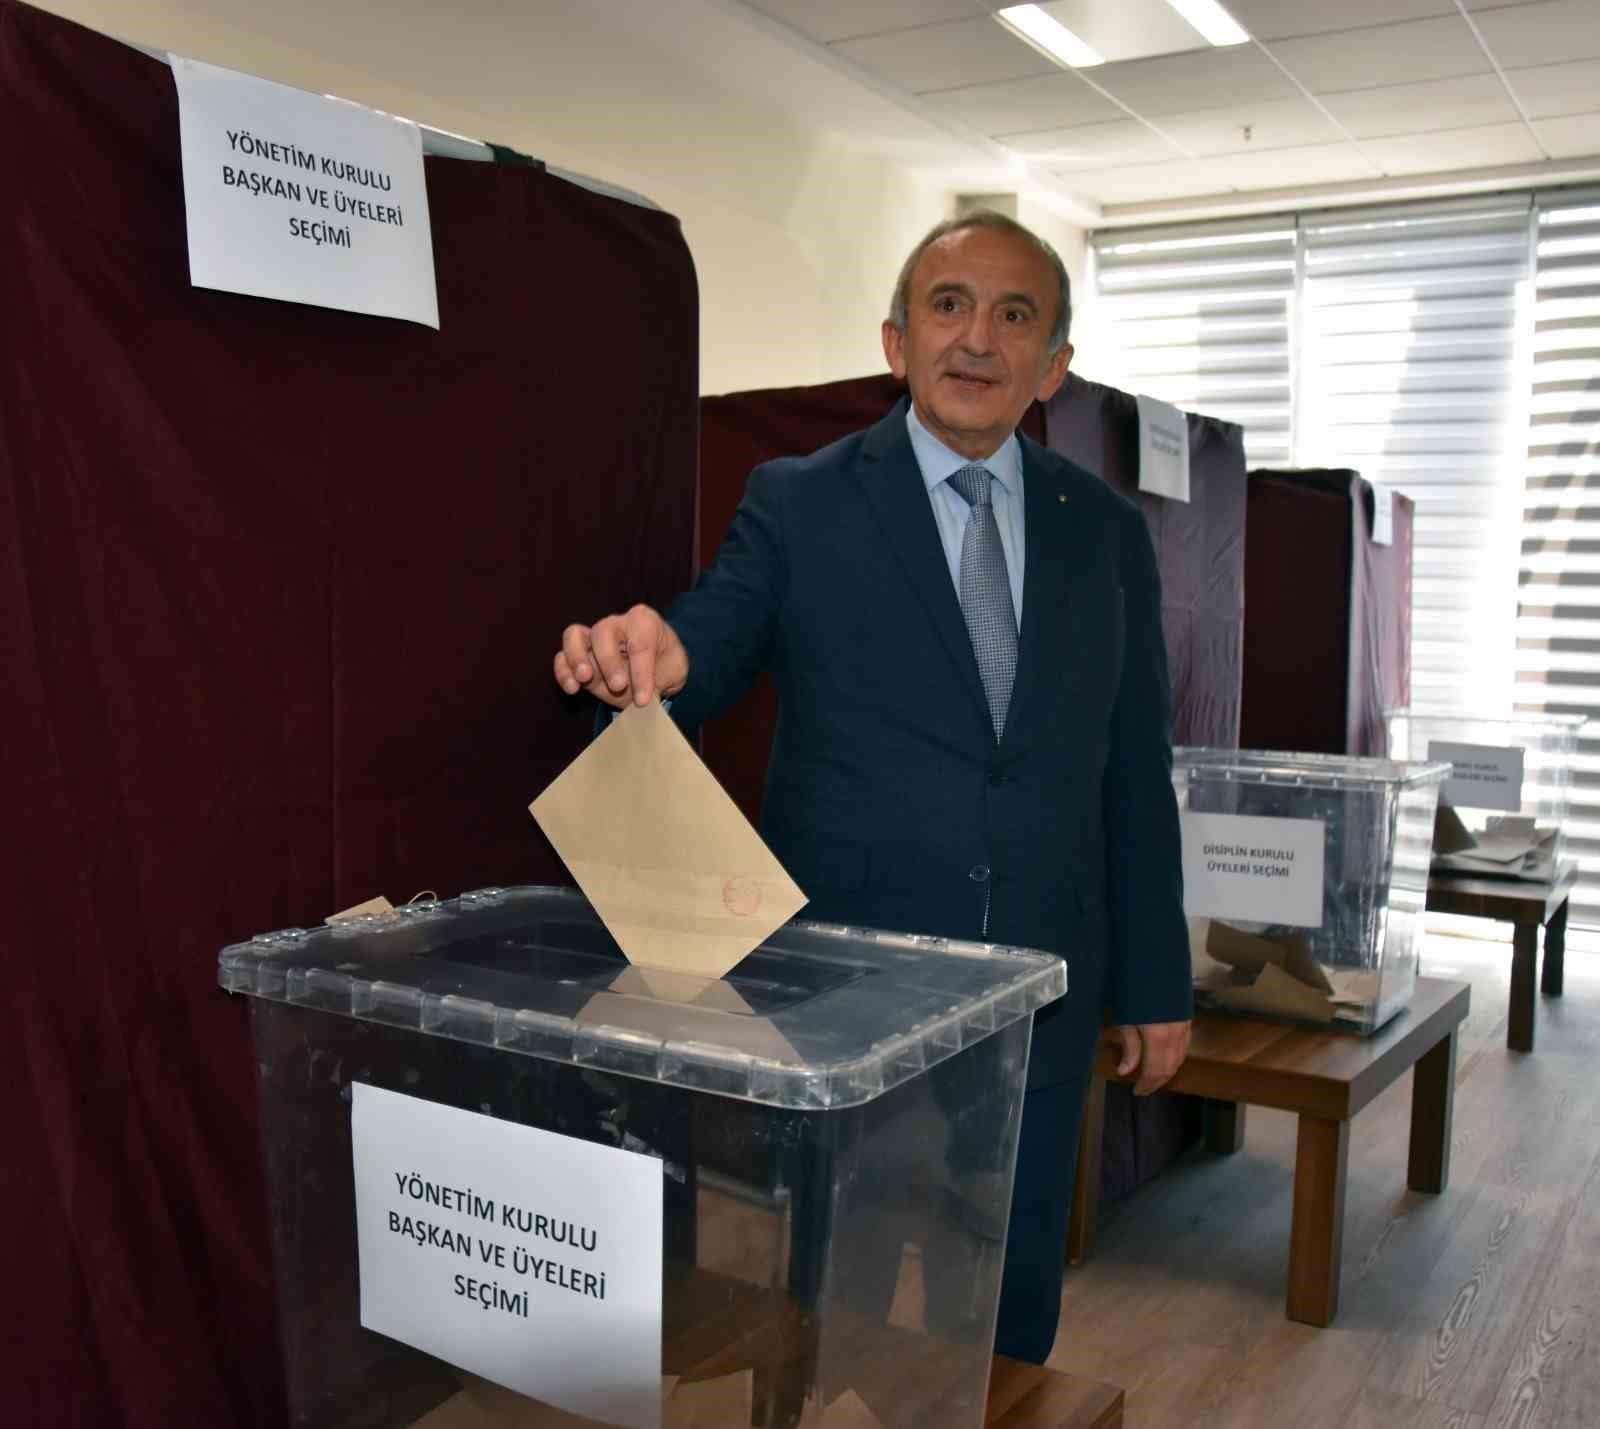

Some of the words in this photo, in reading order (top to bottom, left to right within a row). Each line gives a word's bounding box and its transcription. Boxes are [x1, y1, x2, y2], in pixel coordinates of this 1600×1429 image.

[226, 130, 316, 172] YÖNETİM
[321, 157, 392, 192] KURULU
[222, 165, 301, 202] BAŞKAN
[306, 186, 329, 209] VE
[334, 190, 404, 226] ÜYELERİ
[289, 217, 351, 248] SEÇİMİ
[395, 1172, 494, 1222] YÖNETİM
[502, 1204, 597, 1252] KURULU
[389, 1210, 471, 1257] BAŞKAN
[478, 1239, 505, 1268] VE
[513, 1246, 606, 1300] ÜYELERİ
[454, 1274, 529, 1318] SEÇİMİ
